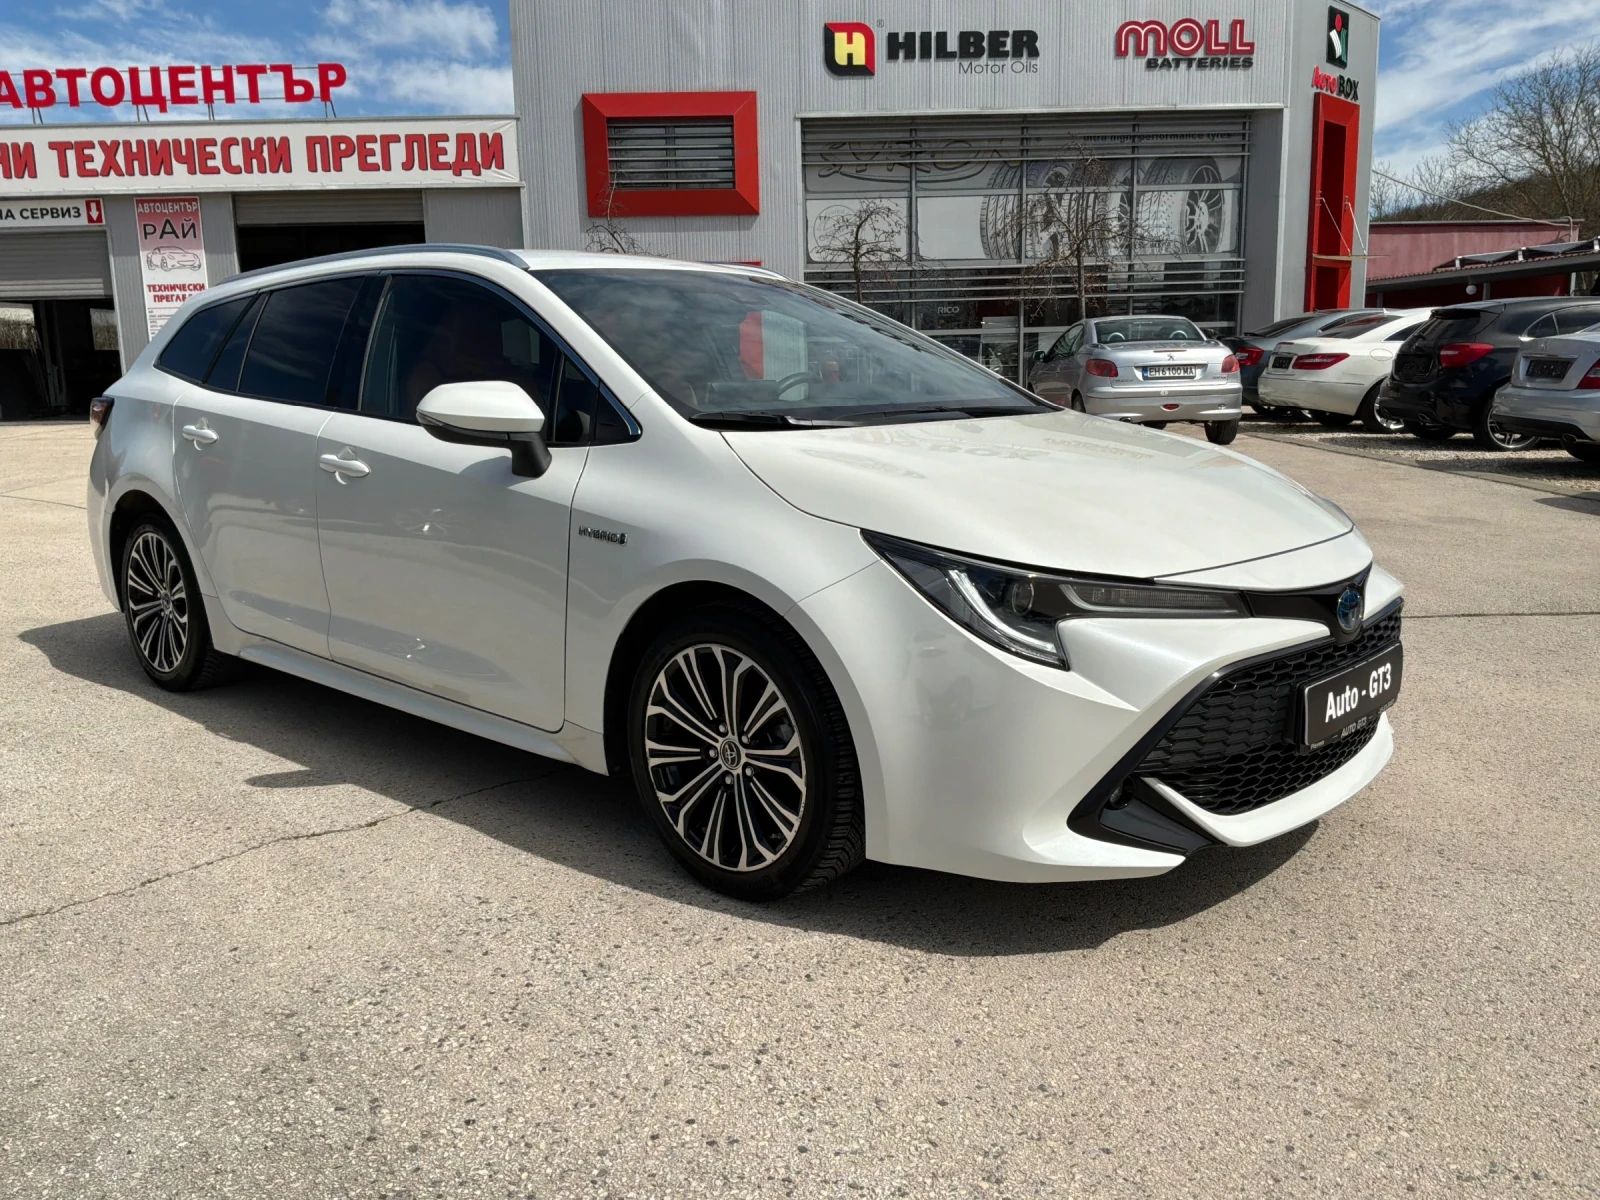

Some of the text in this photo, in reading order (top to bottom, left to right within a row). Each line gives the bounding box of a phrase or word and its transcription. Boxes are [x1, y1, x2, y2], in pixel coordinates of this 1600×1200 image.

[887, 30, 1040, 60] HILBER
[1116, 18, 1254, 57] MOLL
[958, 61, 1039, 74] Motor Oils
[1146, 57, 1253, 69] BATTERIES
[0, 63, 347, 113] АВТОЦЕНТЪР
[48, 136, 292, 178] ТЕХНИЧЕСКИ
[306, 133, 505, 176] ПРЕГЛЕДИ
[19, 206, 81, 220] СЕРВИЗ
[137, 201, 198, 214] АВТОЦЕНТЪР
[143, 217, 197, 240] РАЙ
[147, 283, 205, 293] ТЕХНИЧЕСКИ
[1325, 685, 1359, 724] Auto
[1361, 689, 1367, 697] -
[1369, 662, 1392, 699] GT3
